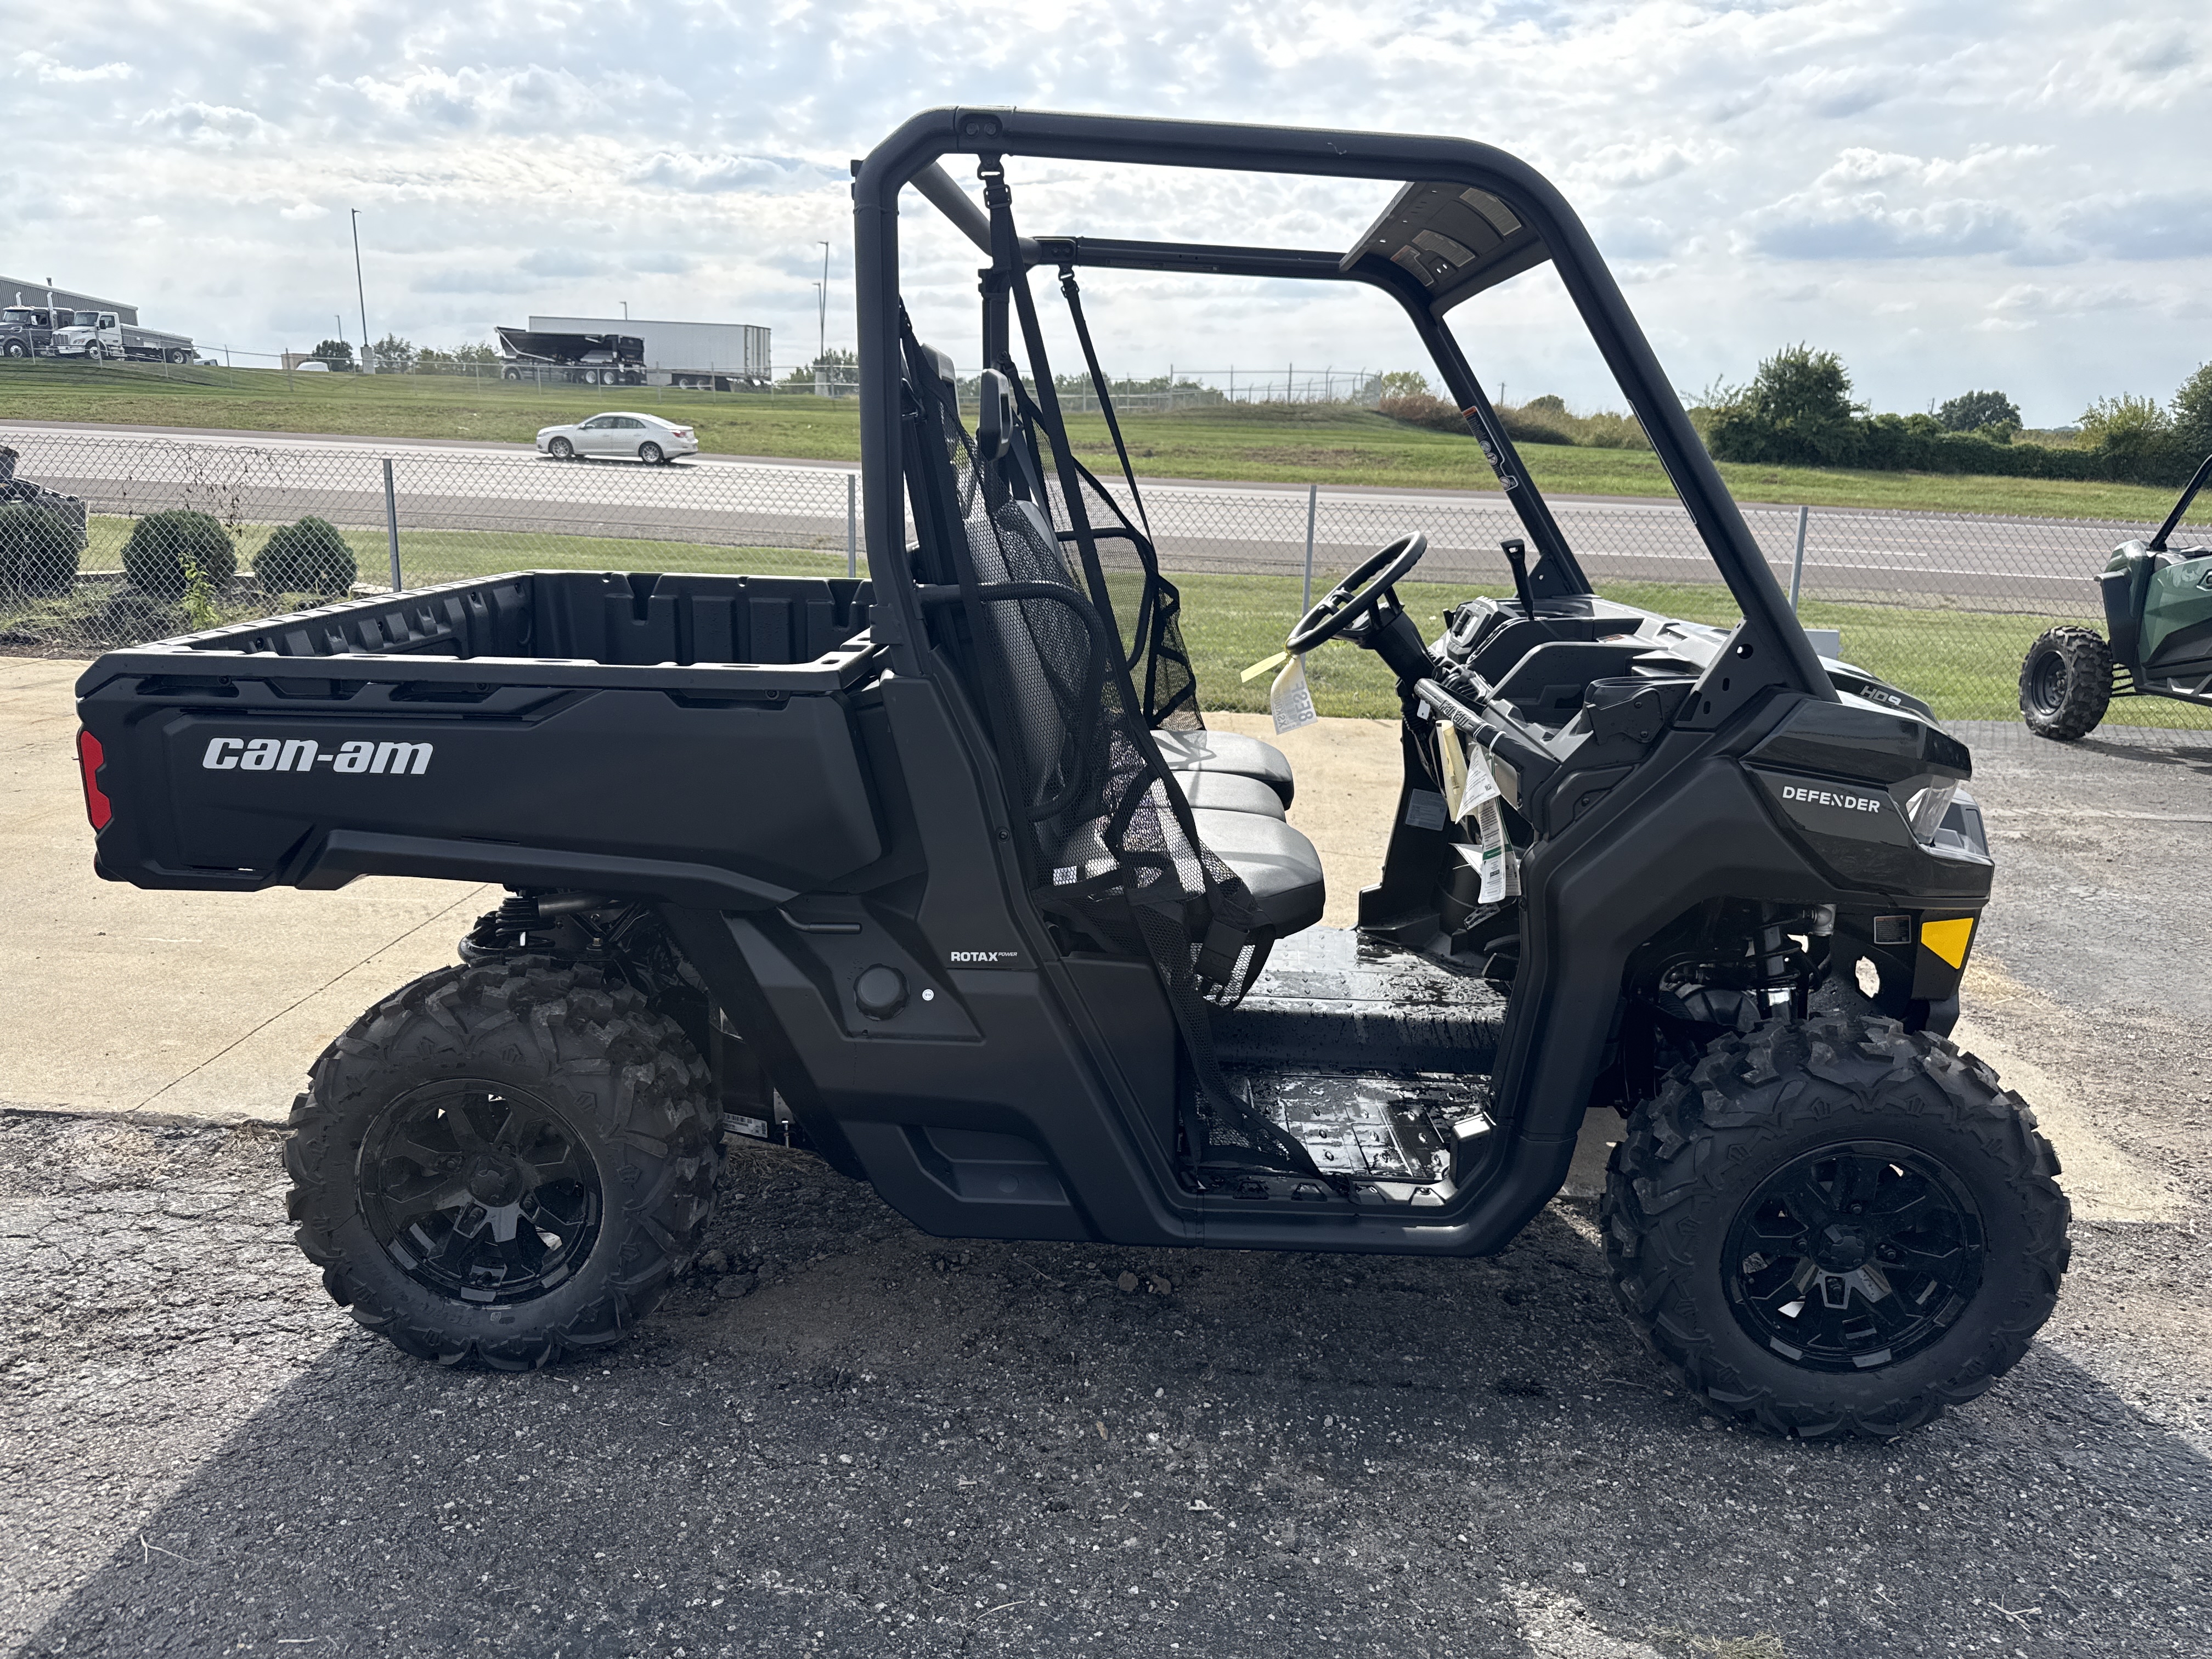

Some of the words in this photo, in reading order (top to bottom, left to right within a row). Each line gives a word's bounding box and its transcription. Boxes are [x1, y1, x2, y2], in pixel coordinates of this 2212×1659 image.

[1860, 685, 1901, 706] HD9
[202, 737, 434, 775] can-am
[1782, 786, 1880, 814] DEFENDER
[951, 952, 998, 961] ROTAX
